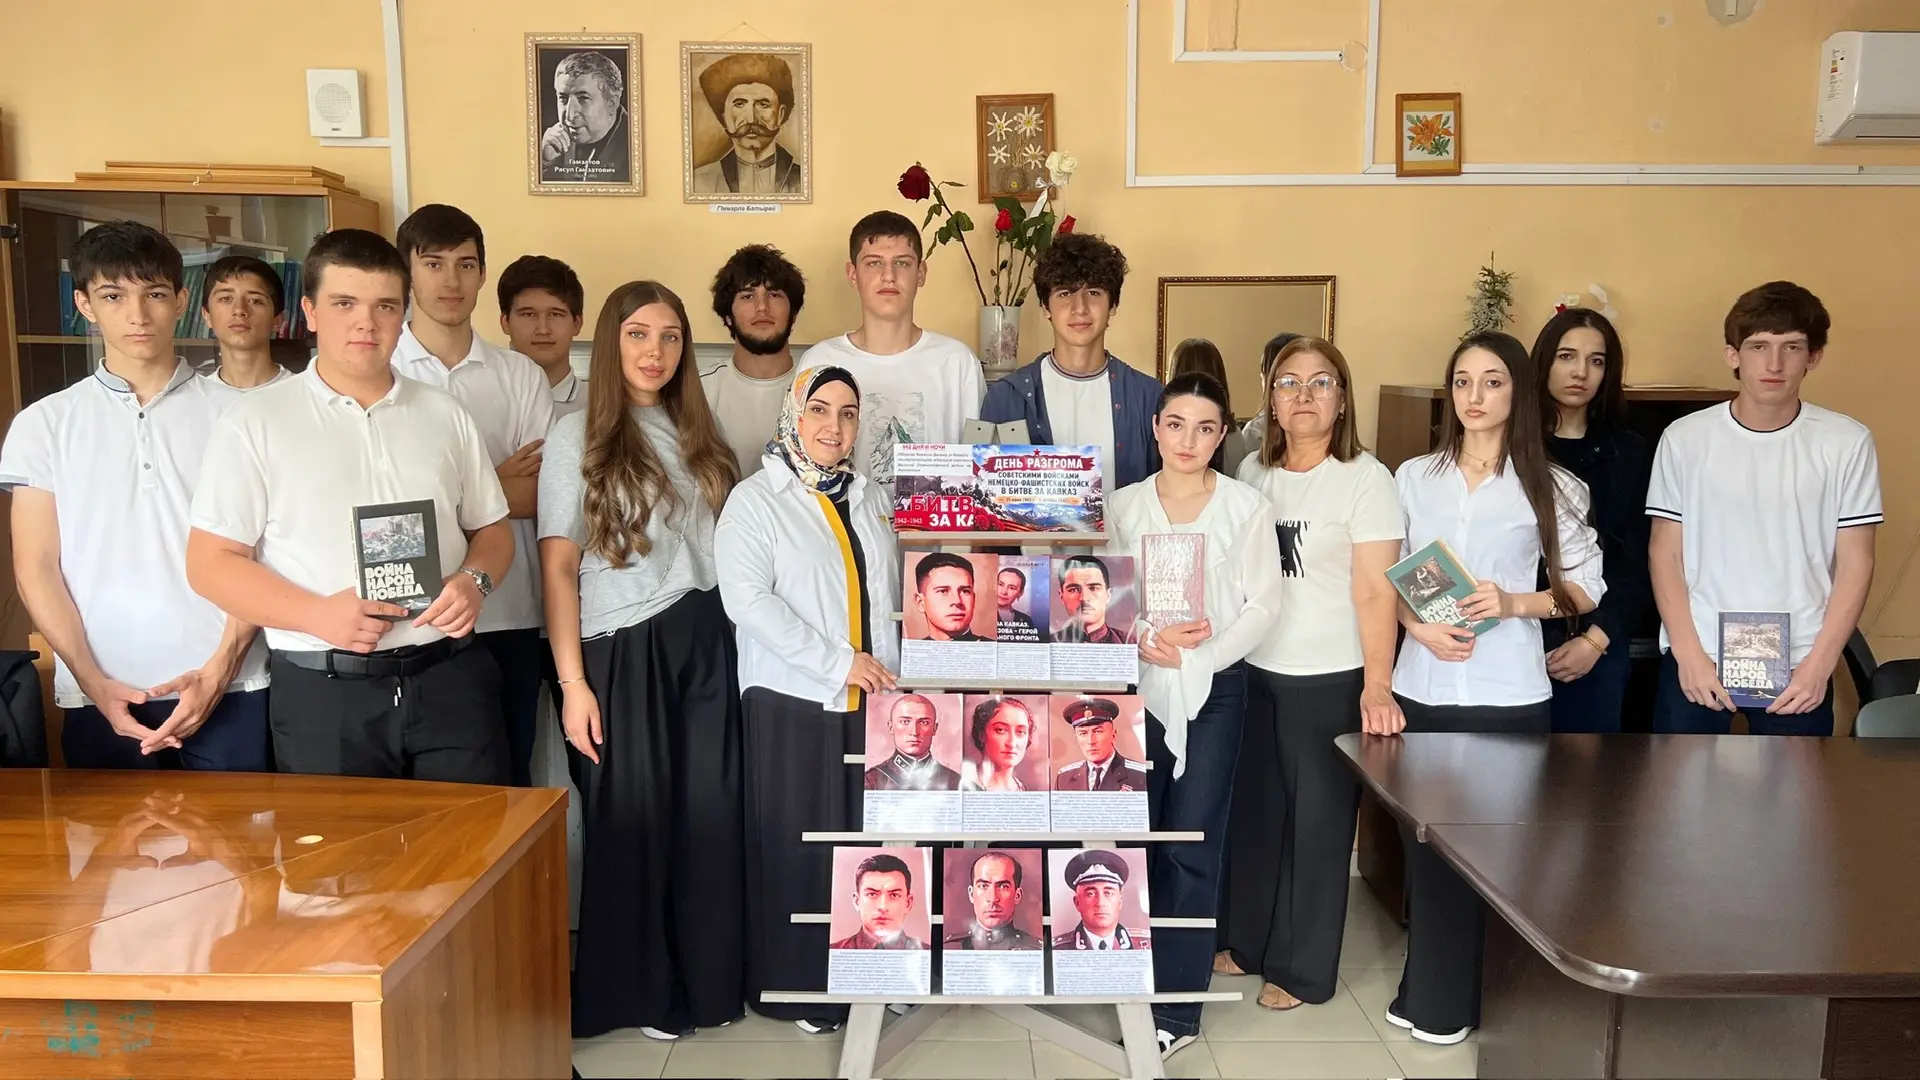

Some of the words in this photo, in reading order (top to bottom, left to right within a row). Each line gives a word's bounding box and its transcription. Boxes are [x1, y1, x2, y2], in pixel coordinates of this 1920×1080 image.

[554, 166, 575, 174] Расул
[575, 166, 616, 174] Гамзатович
[994, 458, 1023, 471] ДЕНЬ
[1027, 458, 1084, 469] РАЗГРОМА
[997, 471, 1042, 479] СОВЕТСКИМИ
[1043, 471, 1080, 480] ВОЙСКАМИ
[987, 478, 1067, 488] НЕМЕЦКО-ФАШИСТСКИХ
[1067, 479, 1090, 488] ВОЙСК
[1001, 487, 1007, 495] В
[1008, 487, 1033, 495] БИТВЕ
[1034, 487, 1045, 495] ЗА
[1046, 487, 1078, 496] КАВКАЗ
[910, 495, 974, 512] БИТВ
[928, 513, 952, 527] ЗА
[364, 563, 414, 579] ВОЙНА
[366, 573, 416, 590] НАРОД
[367, 583, 425, 600] ПОБЕДА
[1420, 594, 1457, 619] ВОЙНА
[1018, 626, 1038, 635] ГЕРОЙ
[1722, 659, 1767, 671] ВОЙНА
[1722, 669, 1767, 680] НАРОД
[1722, 678, 1774, 690] ПОБЕДА
